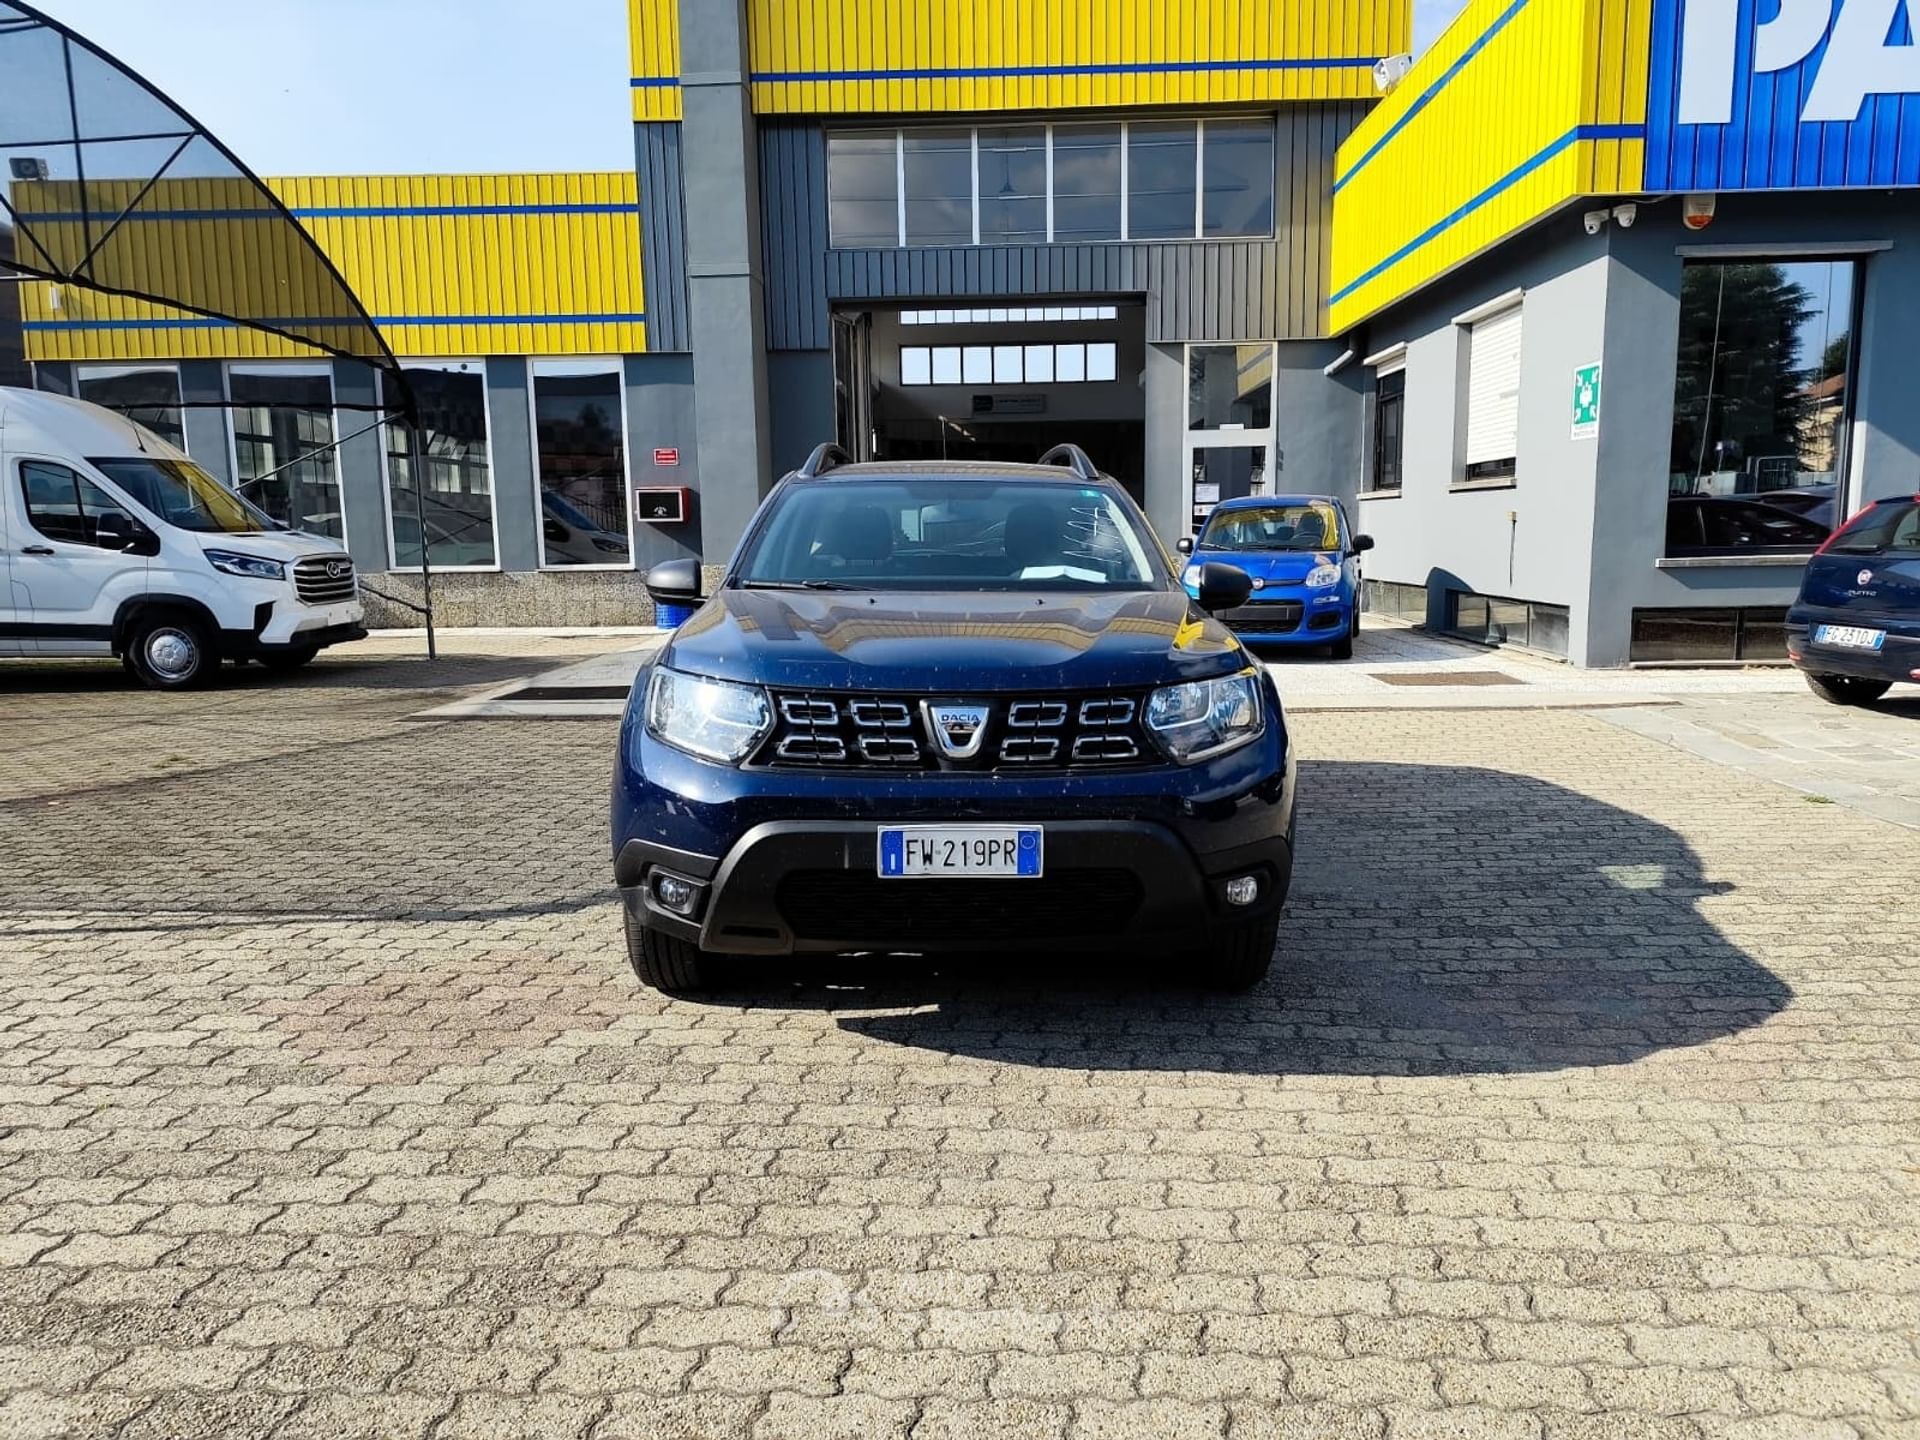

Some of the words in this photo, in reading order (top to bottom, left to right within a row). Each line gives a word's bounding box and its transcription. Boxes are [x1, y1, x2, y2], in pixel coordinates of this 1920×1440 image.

[941, 713, 980, 721] DACIA
[906, 839, 933, 866] FW
[943, 839, 1016, 866] 219PR
